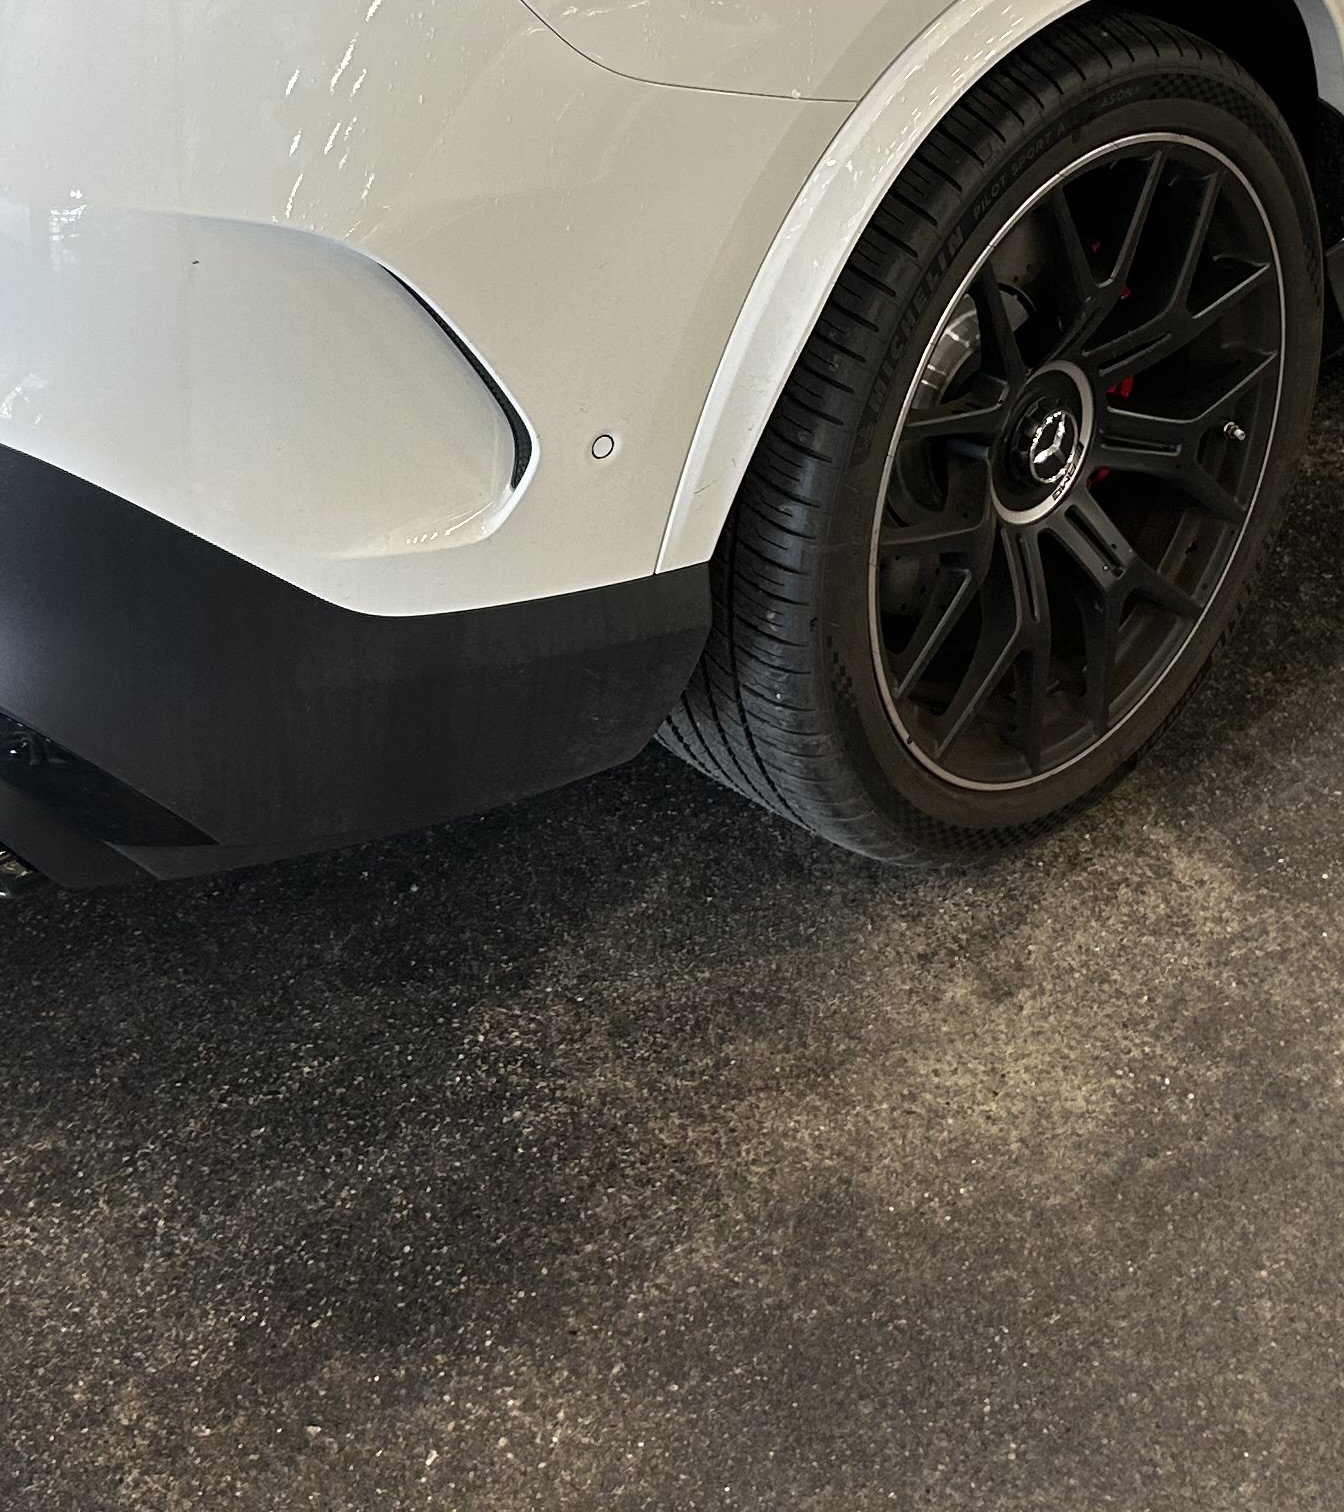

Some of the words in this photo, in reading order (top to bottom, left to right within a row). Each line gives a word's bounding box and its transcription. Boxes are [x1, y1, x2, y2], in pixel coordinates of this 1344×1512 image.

[867, 226, 965, 415] MICHELIN
[973, 176, 1009, 220] PILOT
[1012, 132, 1052, 177] SPORT
